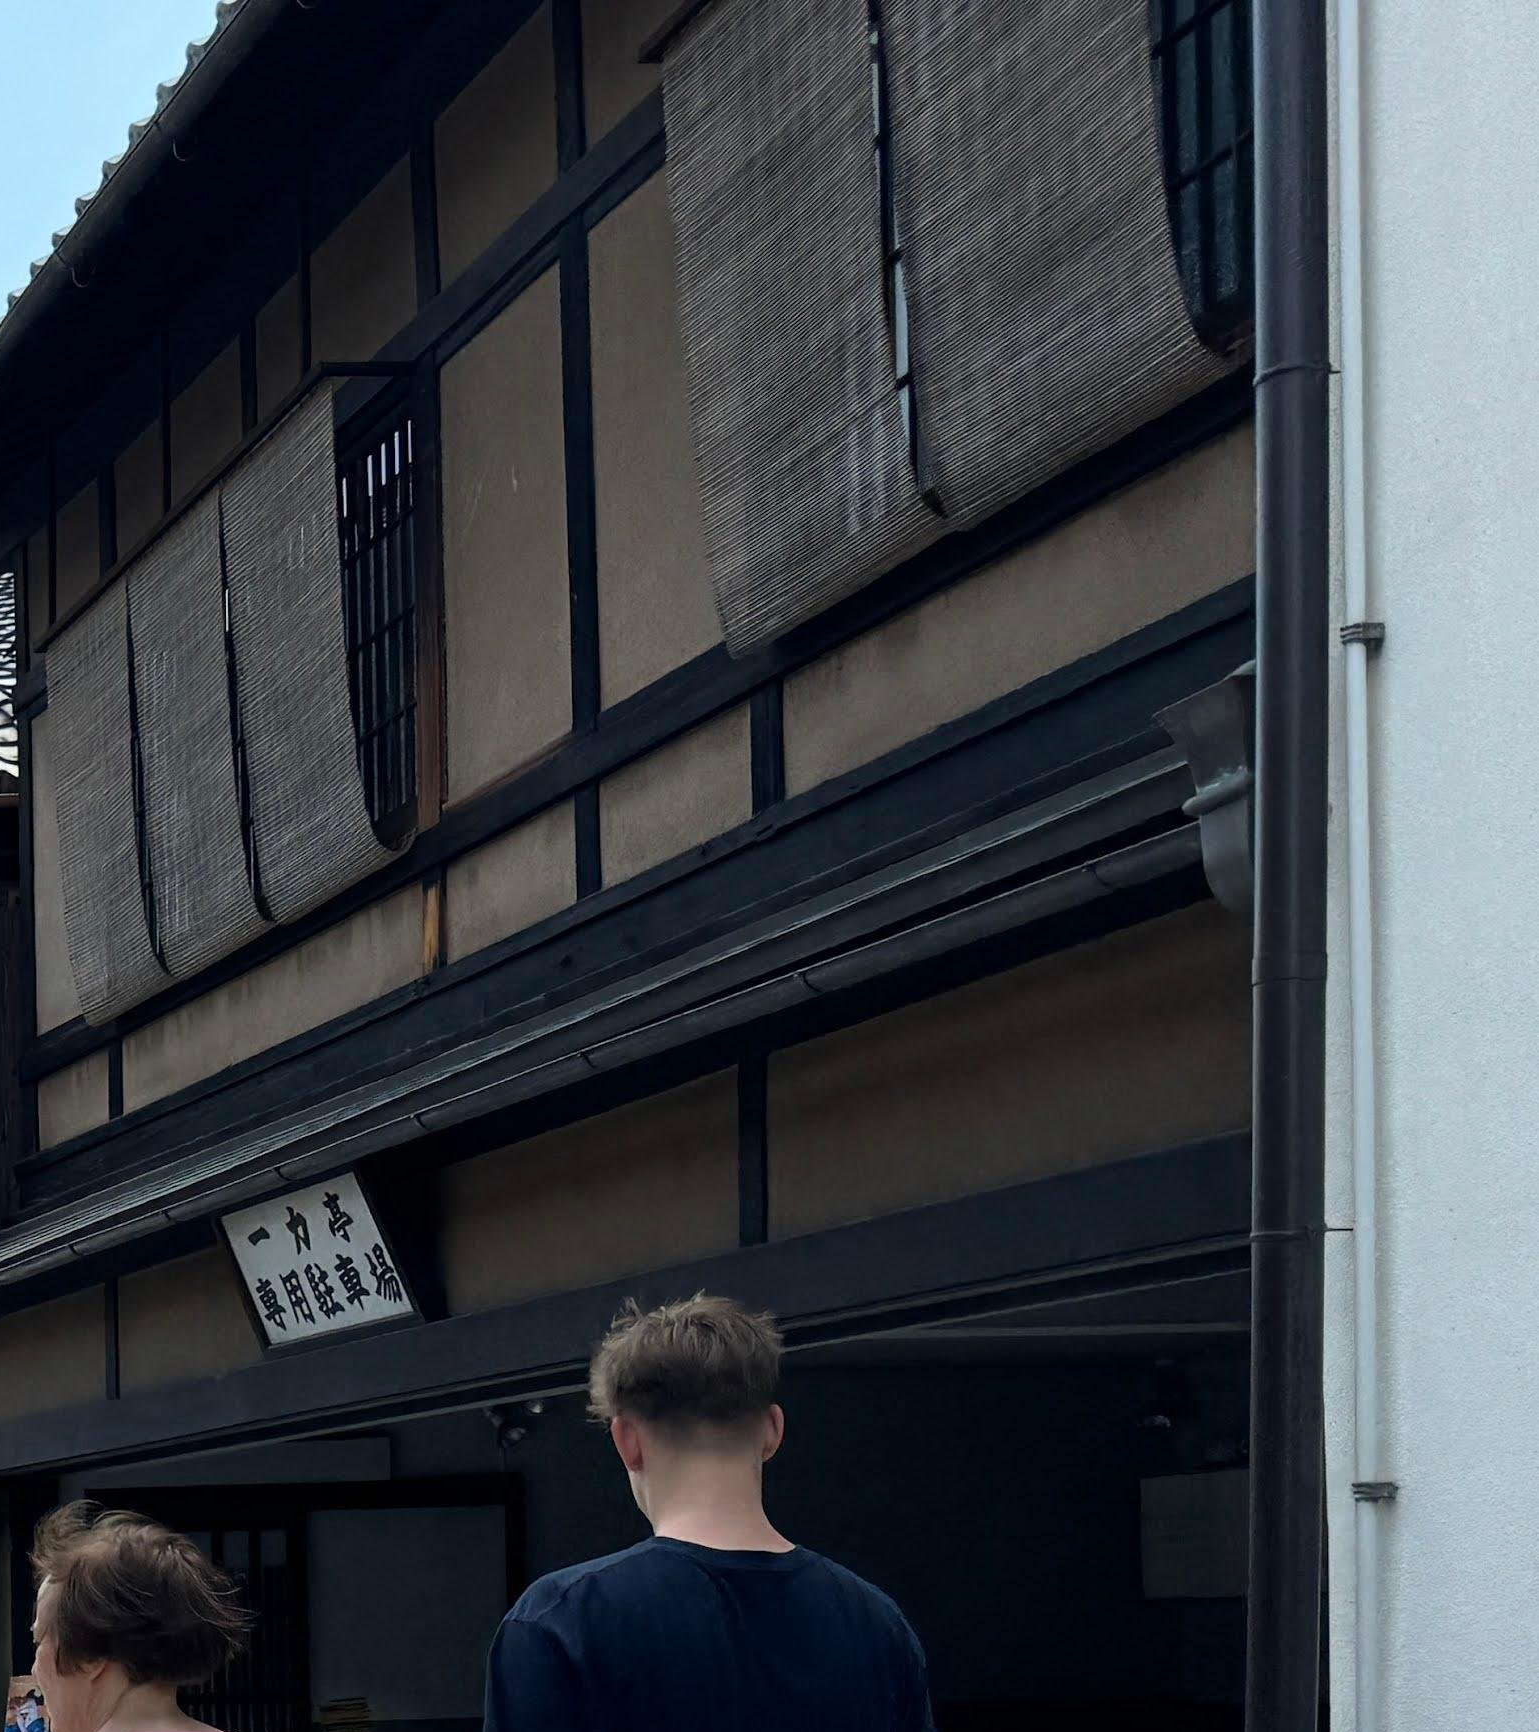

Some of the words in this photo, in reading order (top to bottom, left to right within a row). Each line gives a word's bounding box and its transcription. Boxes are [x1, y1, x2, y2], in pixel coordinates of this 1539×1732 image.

[247, 1191, 354, 1256] 一力亭
[255, 1243, 403, 1331] 専用駐車場
